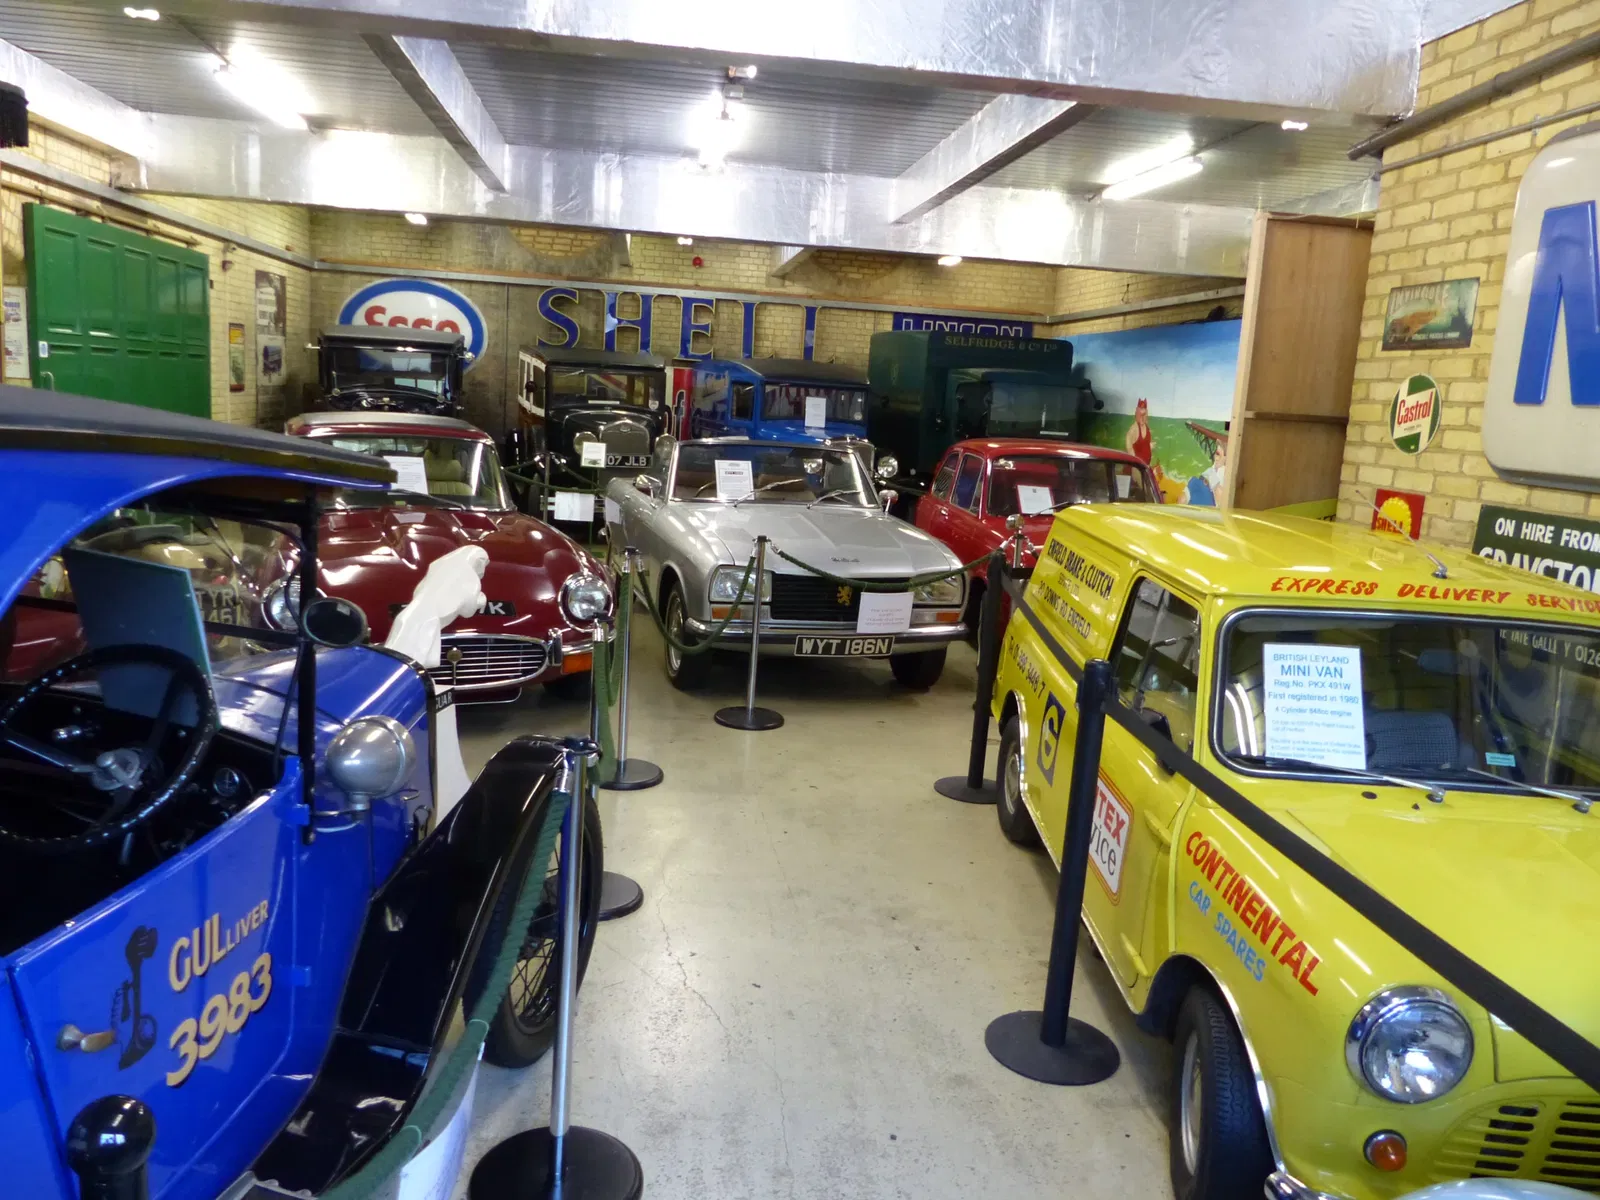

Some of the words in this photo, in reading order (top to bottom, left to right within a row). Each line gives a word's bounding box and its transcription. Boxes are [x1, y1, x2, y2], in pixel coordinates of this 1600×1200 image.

[536, 286, 836, 363] SHELL
[944, 335, 1015, 350] SELFRIDGE
[1397, 391, 1433, 425] Castrol
[624, 456, 647, 466] JLB
[1494, 517, 1516, 537] ON
[1520, 521, 1555, 544] HIRE
[1560, 528, 1600, 553] FROM
[1047, 538, 1068, 566] ENFIELD
[1064, 550, 1085, 579] BRAKE
[1085, 564, 1115, 600] CLUTCH
[1270, 576, 1379, 596] EXPRESS
[1397, 582, 1512, 605] DELIVERY
[1066, 606, 1091, 639] ENFIELD
[802, 638, 841, 655] WYT
[845, 638, 889, 654] 186N
[1273, 653, 1308, 662] BRITISH
[1310, 655, 1349, 665] LEYLAND
[1280, 665, 1311, 677] MINI
[1315, 666, 1343, 678] VAN
[1308, 680, 1326, 688] PKX
[1329, 682, 1351, 691] 491W
[1268, 692, 1285, 700] First
[1288, 693, 1327, 702] registered
[1330, 694, 1337, 702] in
[1340, 695, 1359, 704] 1980
[1281, 706, 1307, 715] Cylinder
[1330, 710, 1352, 718] engine
[1094, 785, 1126, 848] TEX
[1185, 831, 1320, 996] CONTINENTAL
[168, 899, 269, 993] GULLIVER
[1188, 880, 1211, 917] CAR
[1214, 911, 1267, 983] SPARES
[166, 952, 273, 1088] 3983
